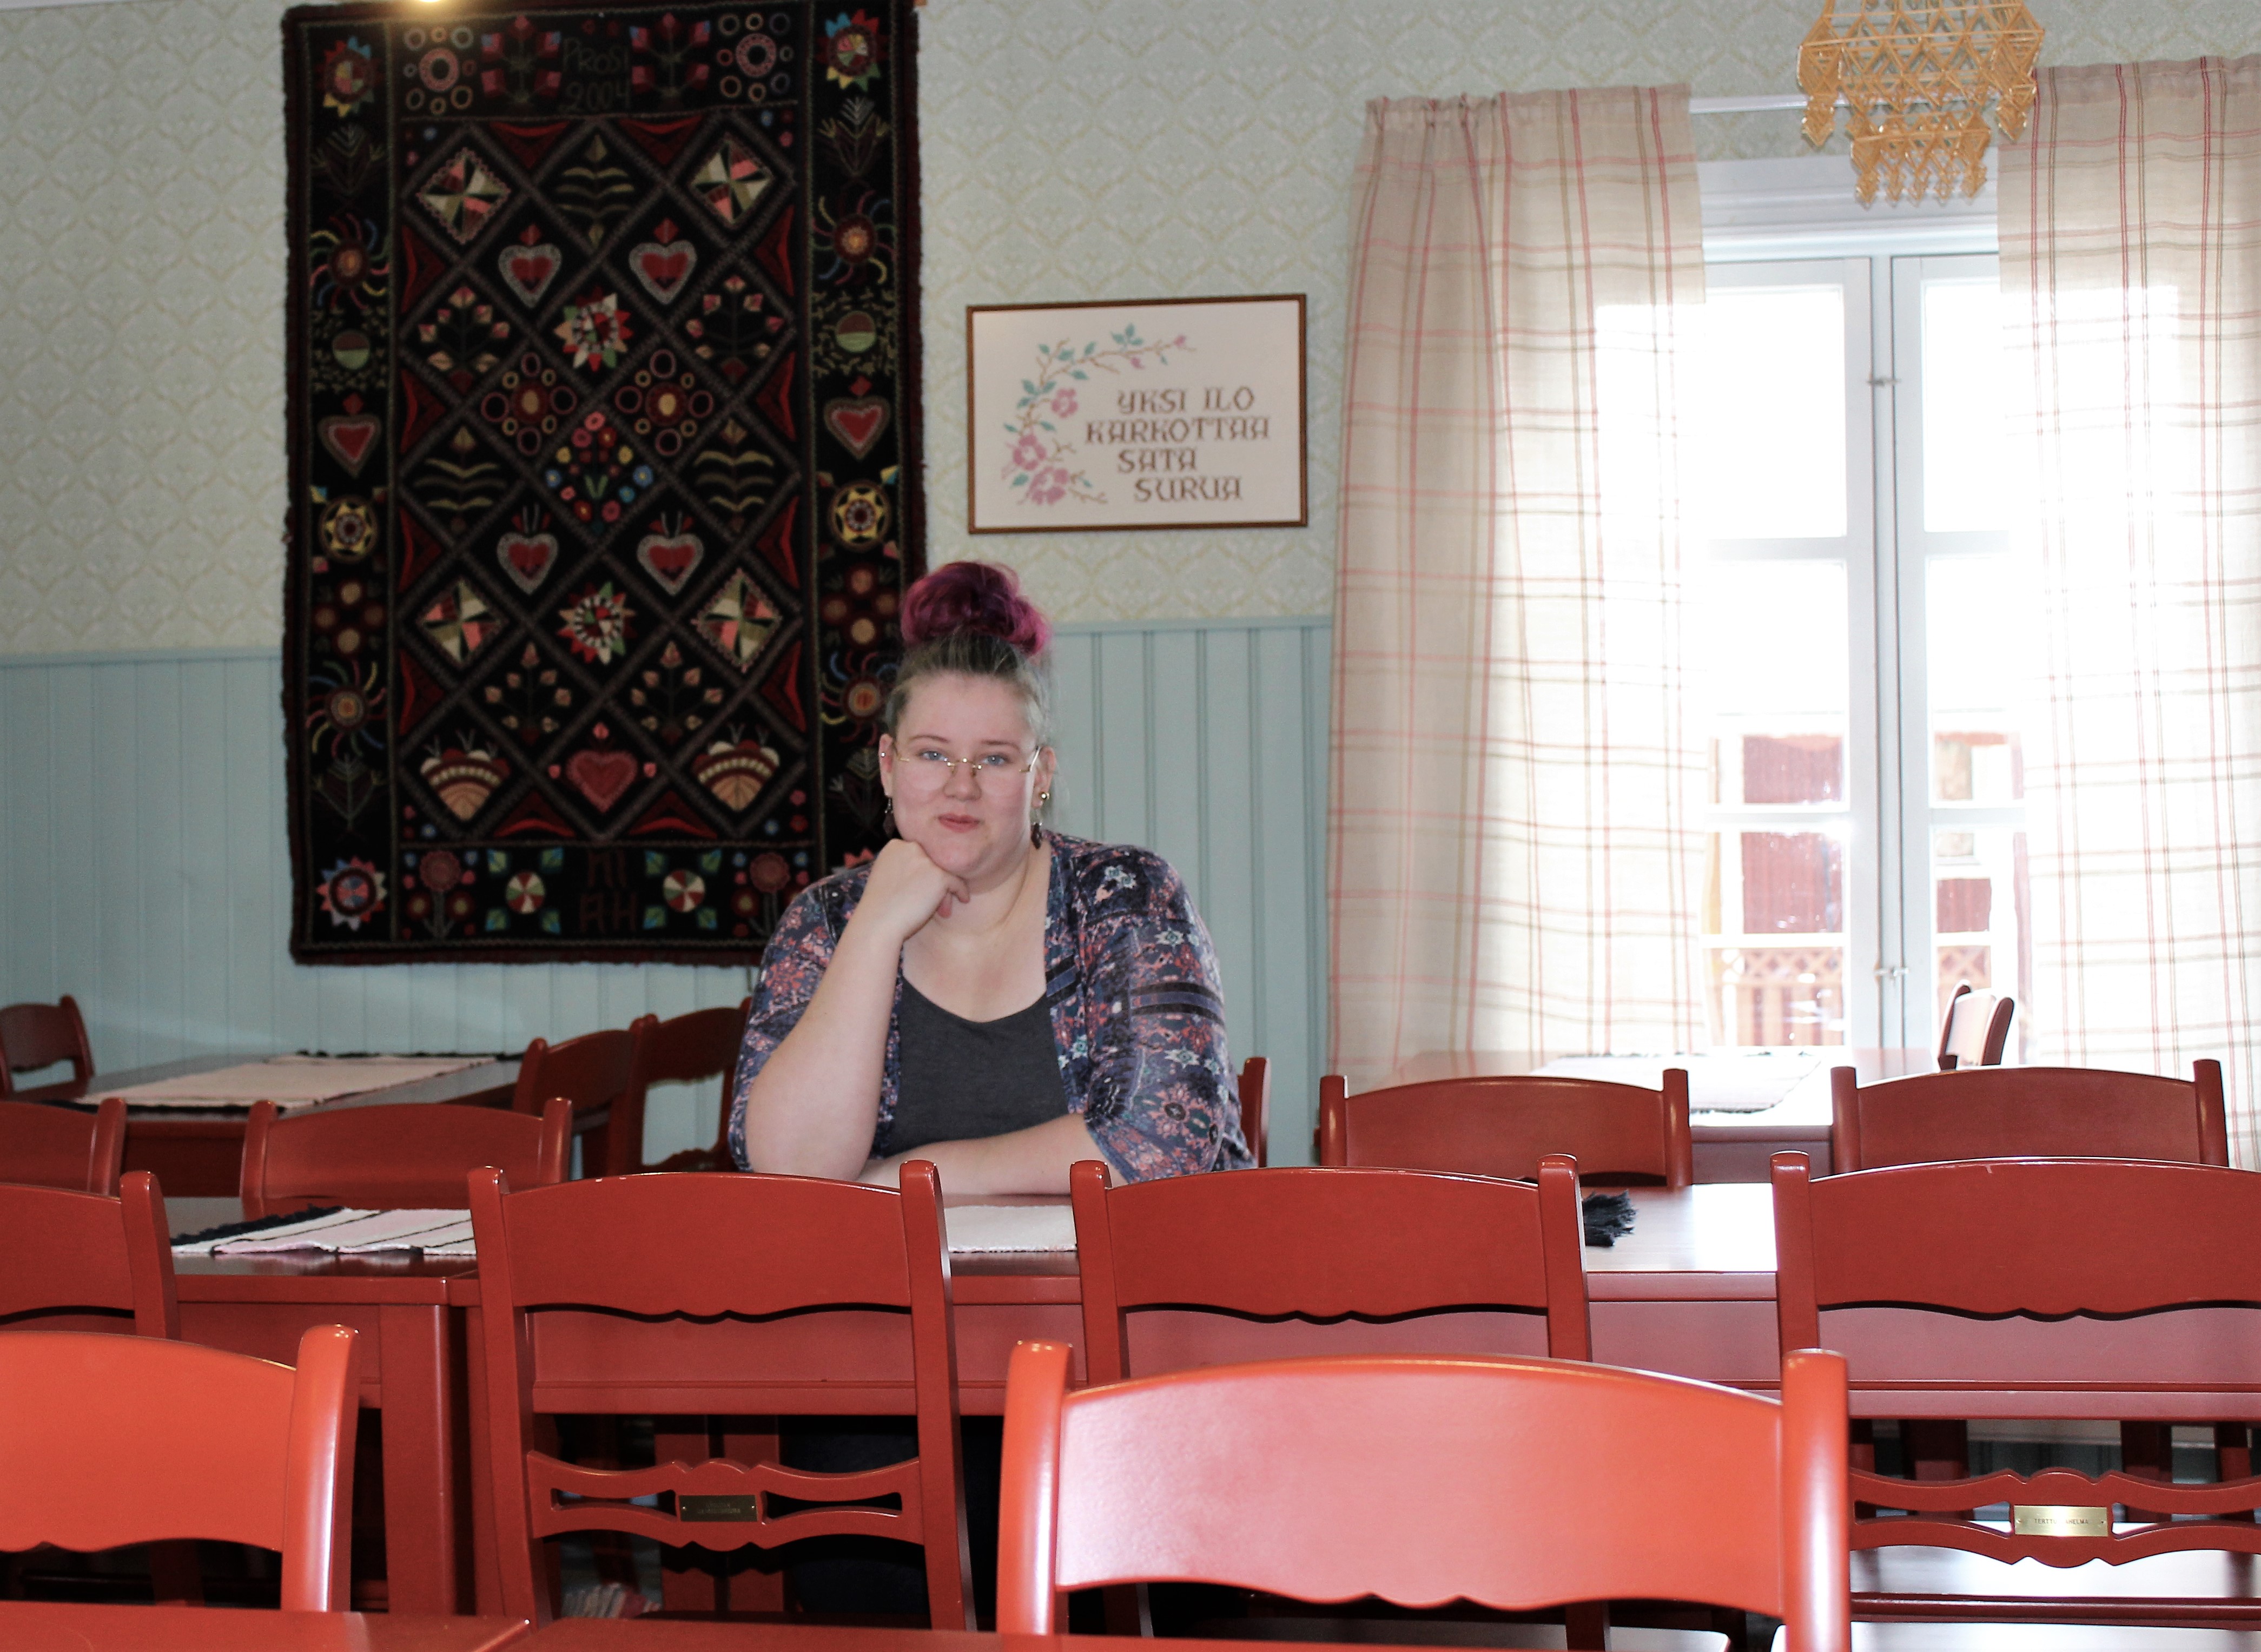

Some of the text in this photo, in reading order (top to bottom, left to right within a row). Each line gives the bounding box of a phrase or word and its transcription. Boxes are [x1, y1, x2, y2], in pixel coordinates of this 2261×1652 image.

[1118, 385, 1255, 414] YKSI ILO
[1086, 415, 1270, 444] KARKOTTAA
[1117, 446, 1196, 473] SATA
[1134, 475, 1242, 503] SURUA
